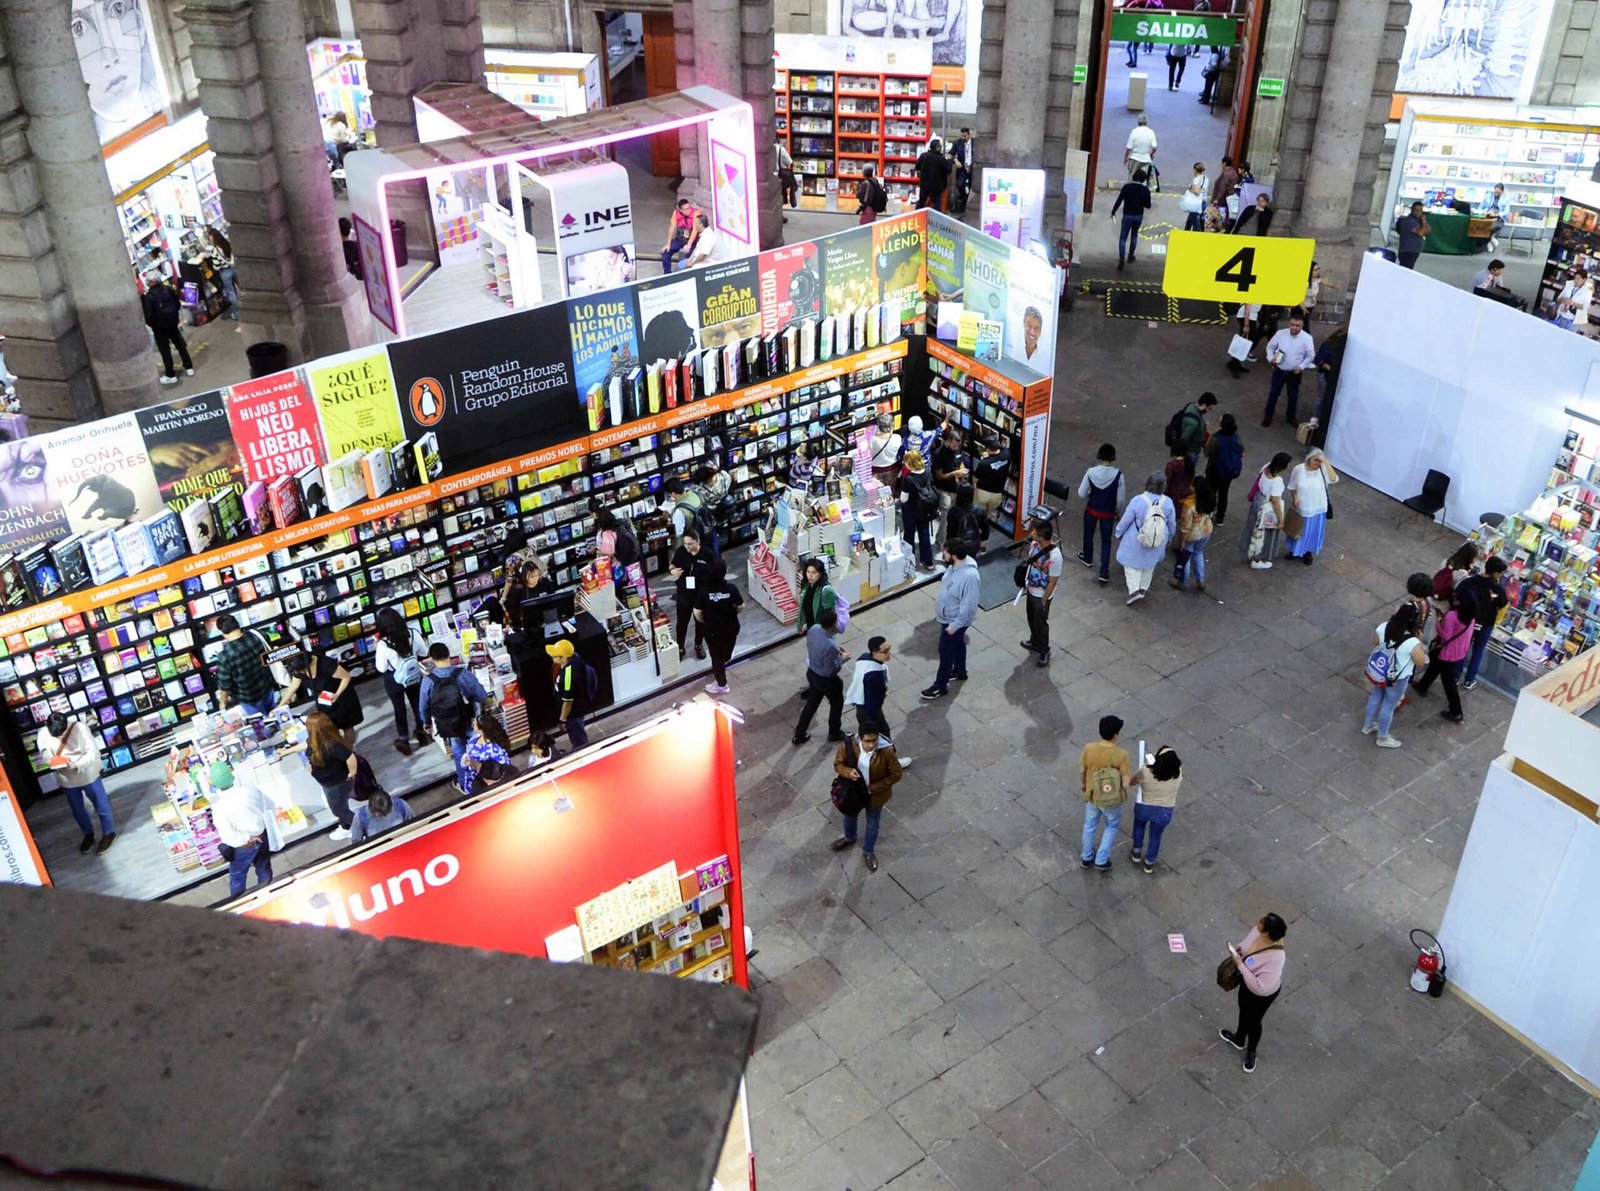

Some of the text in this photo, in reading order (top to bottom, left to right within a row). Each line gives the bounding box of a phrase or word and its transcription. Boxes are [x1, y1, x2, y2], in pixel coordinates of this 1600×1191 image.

[1136, 21, 1208, 39] SALIDA
[1260, 83, 1281, 91] SALIDA
[584, 204, 630, 226] INE
[880, 217, 920, 239] ISABEL
[873, 230, 926, 257] ALLENDE
[927, 241, 955, 261] GANAR
[966, 255, 1008, 288] AHORA
[1215, 247, 1257, 293] 4
[706, 287, 752, 309] GRAN
[722, 284, 735, 293] EL
[575, 302, 625, 320] LO QUE
[702, 298, 757, 326] CORRUPTOR
[762, 269, 778, 337] ZQUIERDA
[569, 315, 633, 352] HICIMOS
[585, 328, 611, 346] MAL
[576, 348, 594, 364] LOS
[329, 362, 374, 388] ¿QUÉ
[461, 359, 520, 384] Penguin
[463, 362, 566, 398] Random House
[251, 388, 272, 398] LILIA
[322, 378, 388, 408] SIGUE?
[465, 372, 569, 411] Grupo Editorial
[154, 402, 208, 422] FRANCISCO
[183, 408, 225, 427] MORENO
[240, 394, 302, 421] HIJOS DEL
[666, 404, 720, 425] HISPANOAMERICANA
[679, 402, 708, 415] NARRATIVA
[47, 420, 133, 449] Anamar Orihuela
[255, 411, 295, 438] NEO
[593, 421, 657, 448] CONTEMPORÁNEA
[249, 427, 313, 461] LIBERA
[341, 430, 393, 454] DENISE
[520, 442, 585, 468] PREMIOS NOBEL
[57, 452, 147, 488] HUEVOTES
[72, 446, 124, 469] DOÑA
[253, 447, 316, 480] LISMO
[1027, 424, 1039, 513] enguinlibros.com/mx
[172, 467, 231, 496] DIME QUE
[440, 464, 513, 493] CONTEMPORÁNEA
[0, 503, 34, 520] OHN
[167, 497, 186, 513] NO
[361, 489, 432, 516] TEMAS PARA DEBATIR
[0, 508, 66, 536] ZENBACH
[274, 514, 350, 543] LA MEJOR LITERATURA
[0, 527, 67, 551] SICOANALISTA
[184, 541, 264, 572] LA MEJOR LITERATURA
[91, 572, 168, 602] LIBROS SINGULARES
